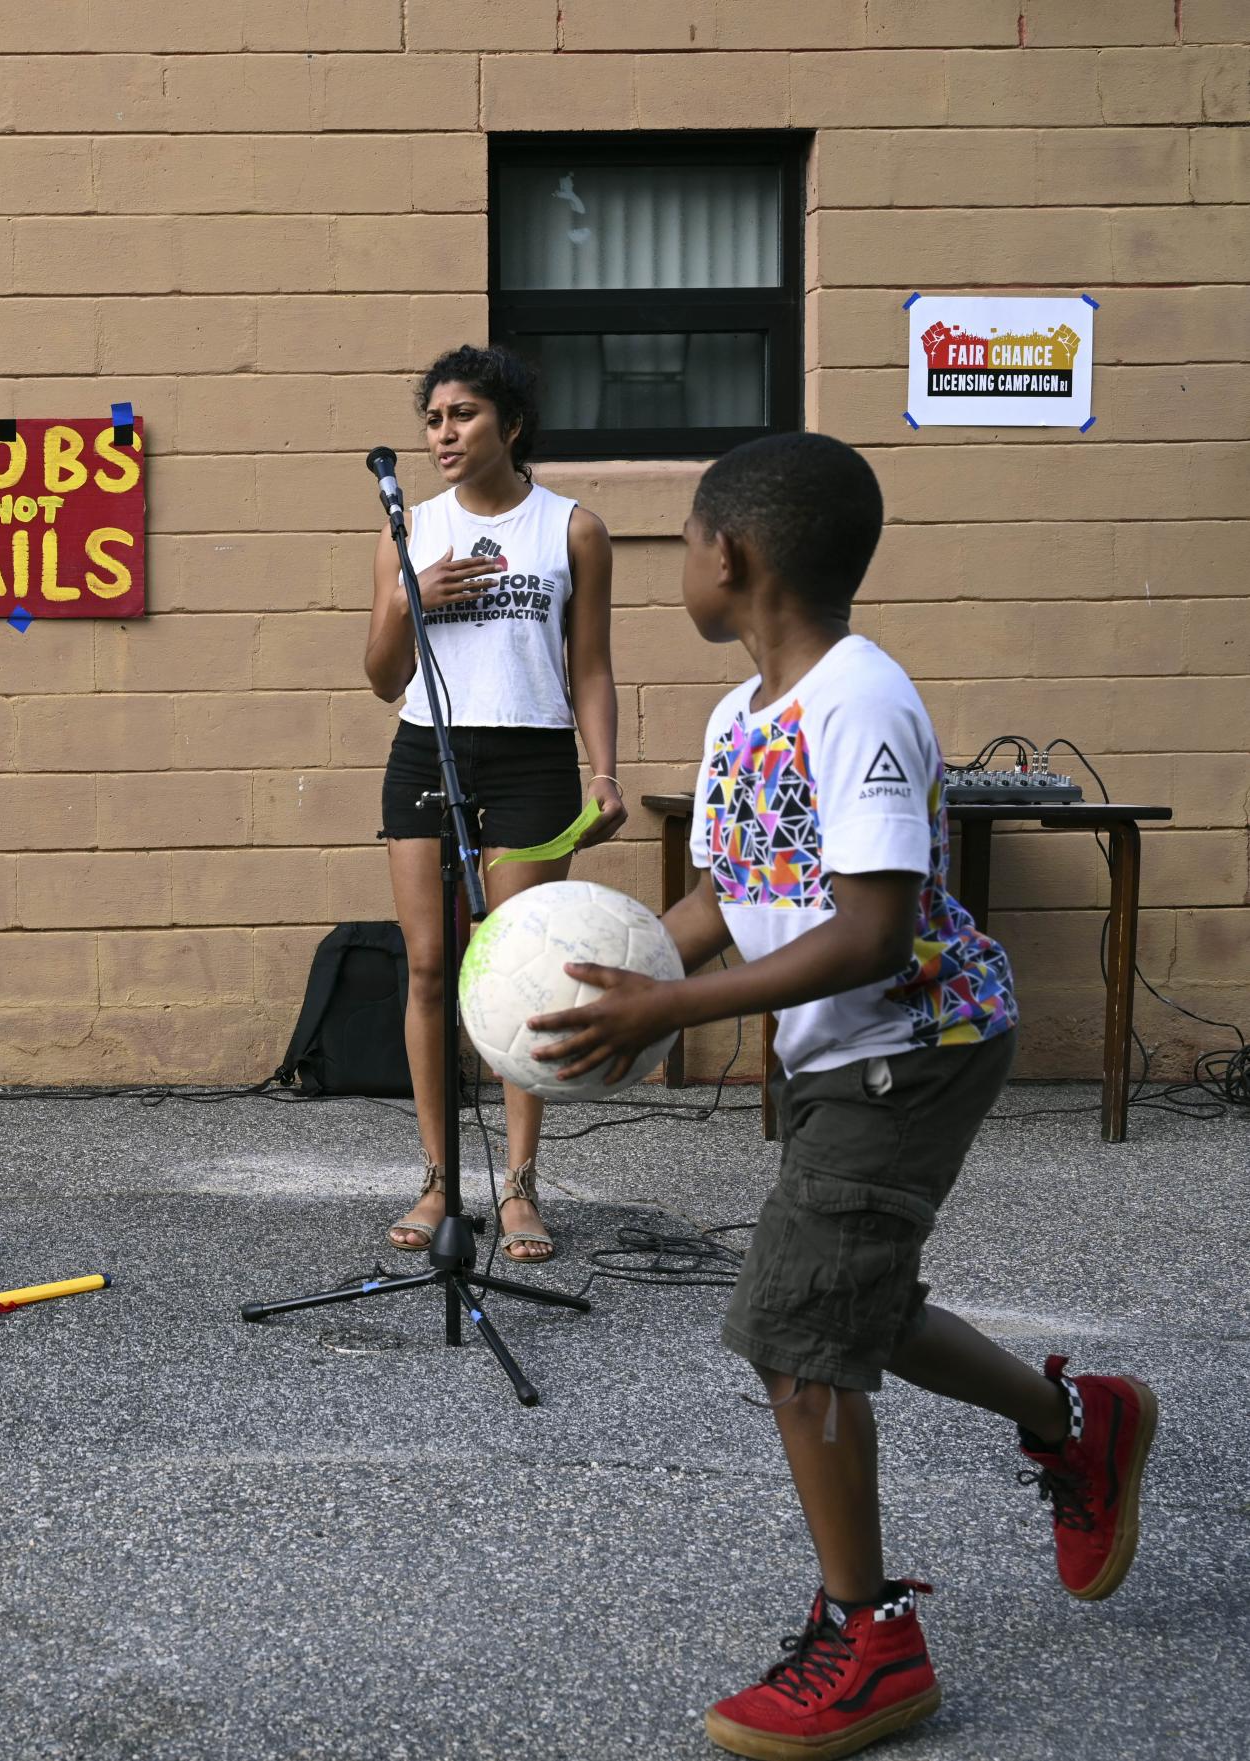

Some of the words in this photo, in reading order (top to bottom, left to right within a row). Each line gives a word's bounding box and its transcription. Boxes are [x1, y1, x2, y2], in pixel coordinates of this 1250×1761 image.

[948, 344, 985, 366] FAIR
[991, 345, 1053, 367] CHANCE
[932, 374, 995, 391] LICENSING
[998, 374, 1059, 392] CAMPAIGN
[1060, 381, 1068, 392] RI
[500, 574, 540, 591] FOR
[483, 590, 551, 612] POWER
[859, 787, 912, 799] ASPHALT
